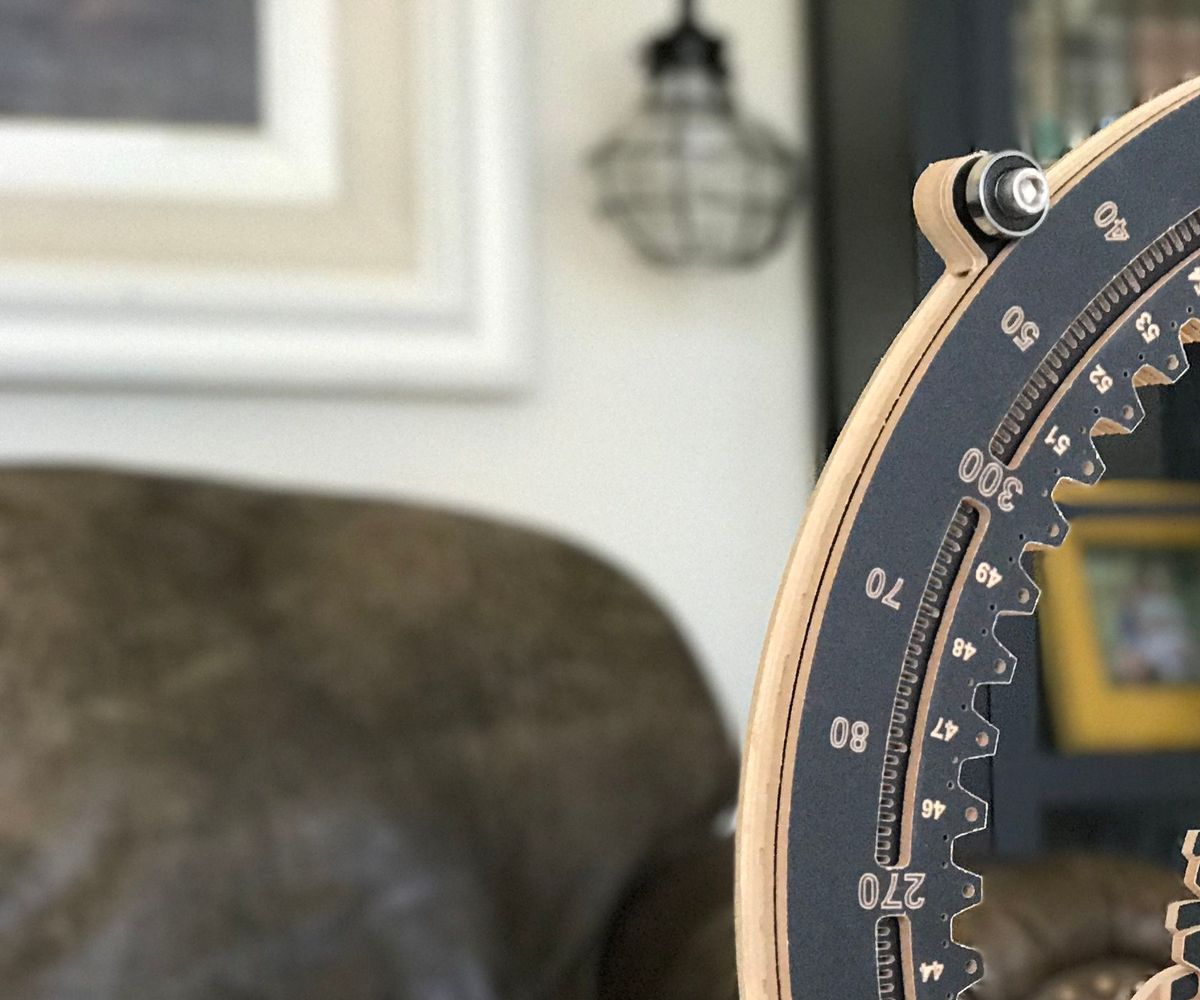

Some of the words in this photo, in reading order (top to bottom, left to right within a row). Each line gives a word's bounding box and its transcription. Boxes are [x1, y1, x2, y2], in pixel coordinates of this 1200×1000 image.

[1093, 200, 1130, 241] 40
[1001, 305, 1040, 352] 50
[1135, 311, 1161, 344] 53
[1089, 363, 1113, 394] 52
[1044, 424, 1071, 457] 51
[958, 447, 1024, 512] 300
[865, 566, 905, 611] 70
[975, 562, 1003, 589] 49
[952, 637, 977, 661] 48
[829, 716, 869, 753] 80
[930, 716, 959, 742] 47
[921, 798, 946, 821] 46
[857, 872, 926, 910] 270
[919, 960, 945, 983] 44
